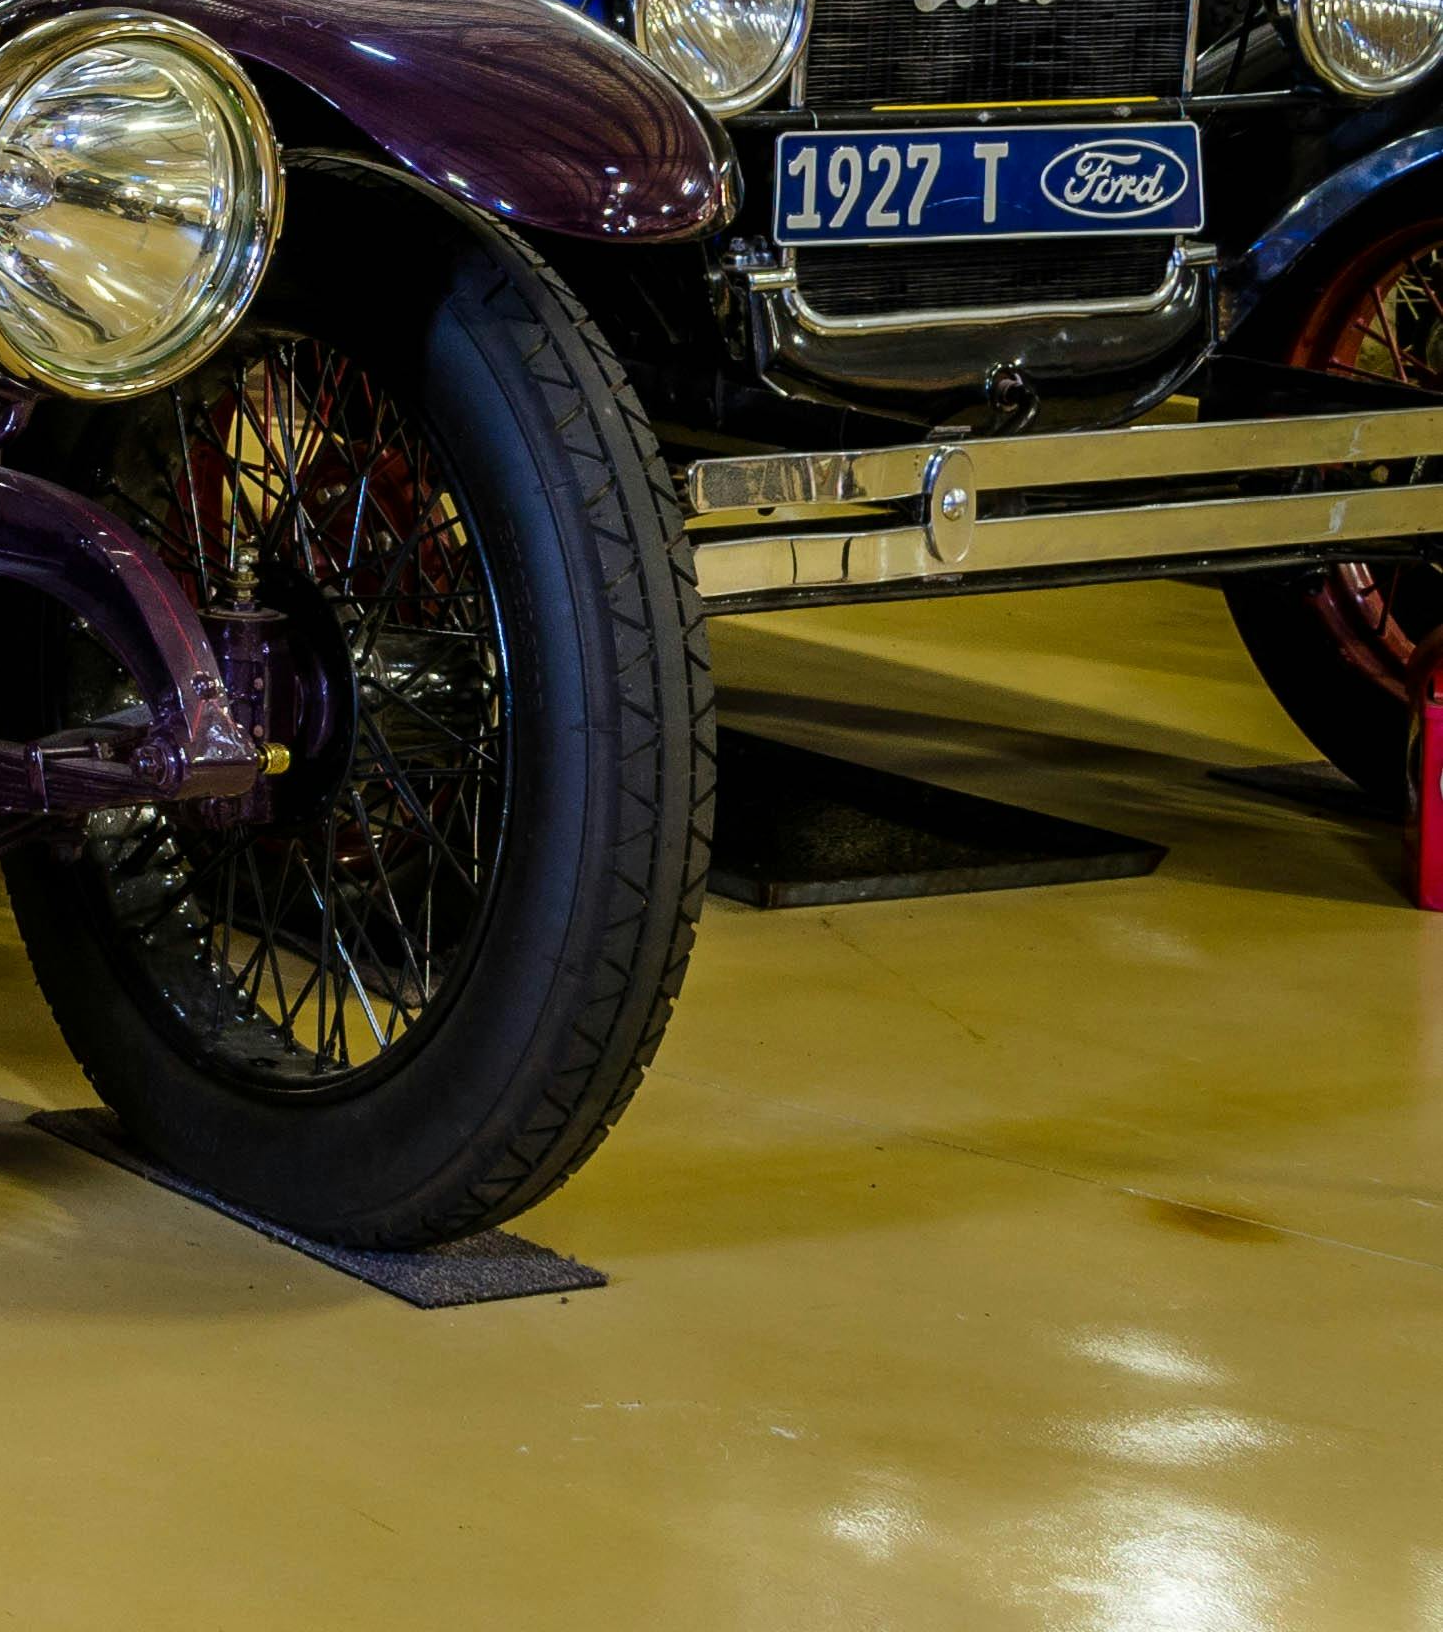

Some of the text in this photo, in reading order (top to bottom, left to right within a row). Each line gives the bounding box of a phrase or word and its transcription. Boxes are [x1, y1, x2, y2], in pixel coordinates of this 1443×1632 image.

[785, 141, 1166, 230] 1927 T Ford
